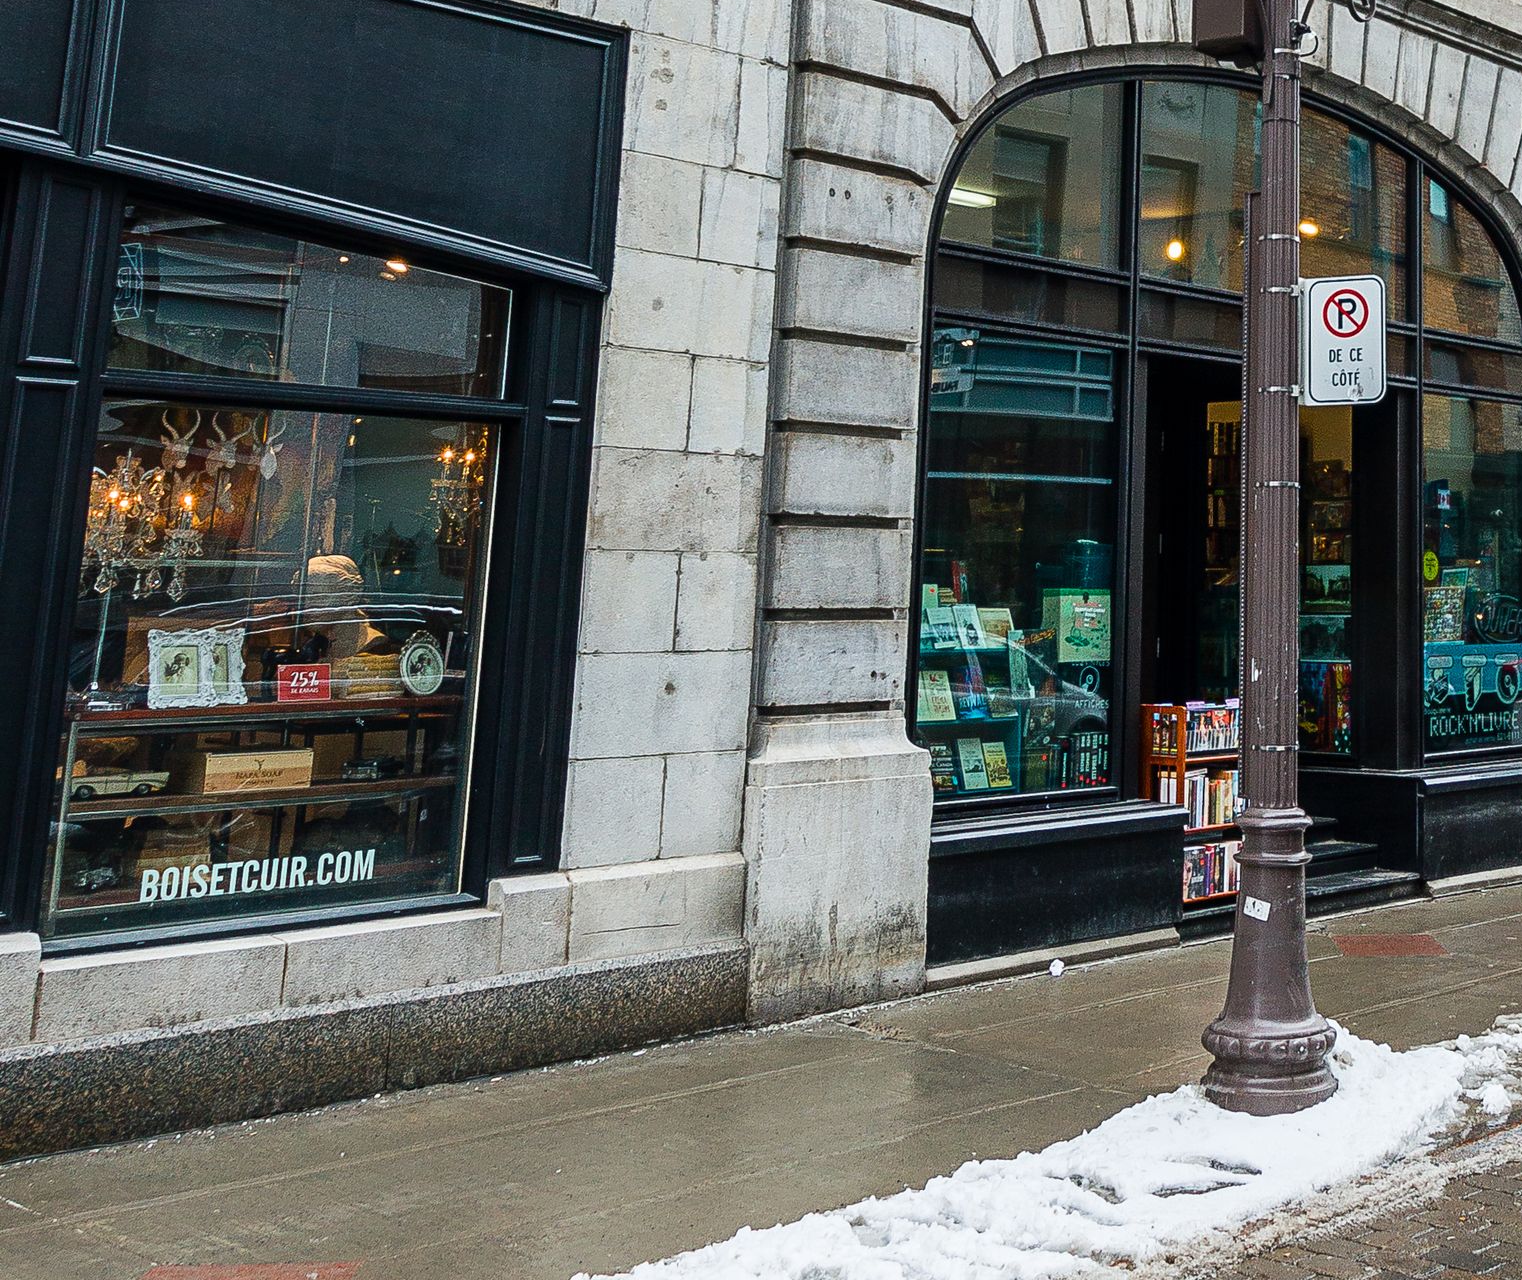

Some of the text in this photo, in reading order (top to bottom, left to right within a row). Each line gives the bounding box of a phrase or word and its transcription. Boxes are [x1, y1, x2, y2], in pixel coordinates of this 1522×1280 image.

[1328, 347, 1364, 363] DE CE
[1331, 368, 1361, 387] CÔTÉ
[290, 670, 320, 688] 25%
[1074, 699, 1110, 710] AFFICHES
[139, 848, 377, 904] BOISETCUIR.COM
